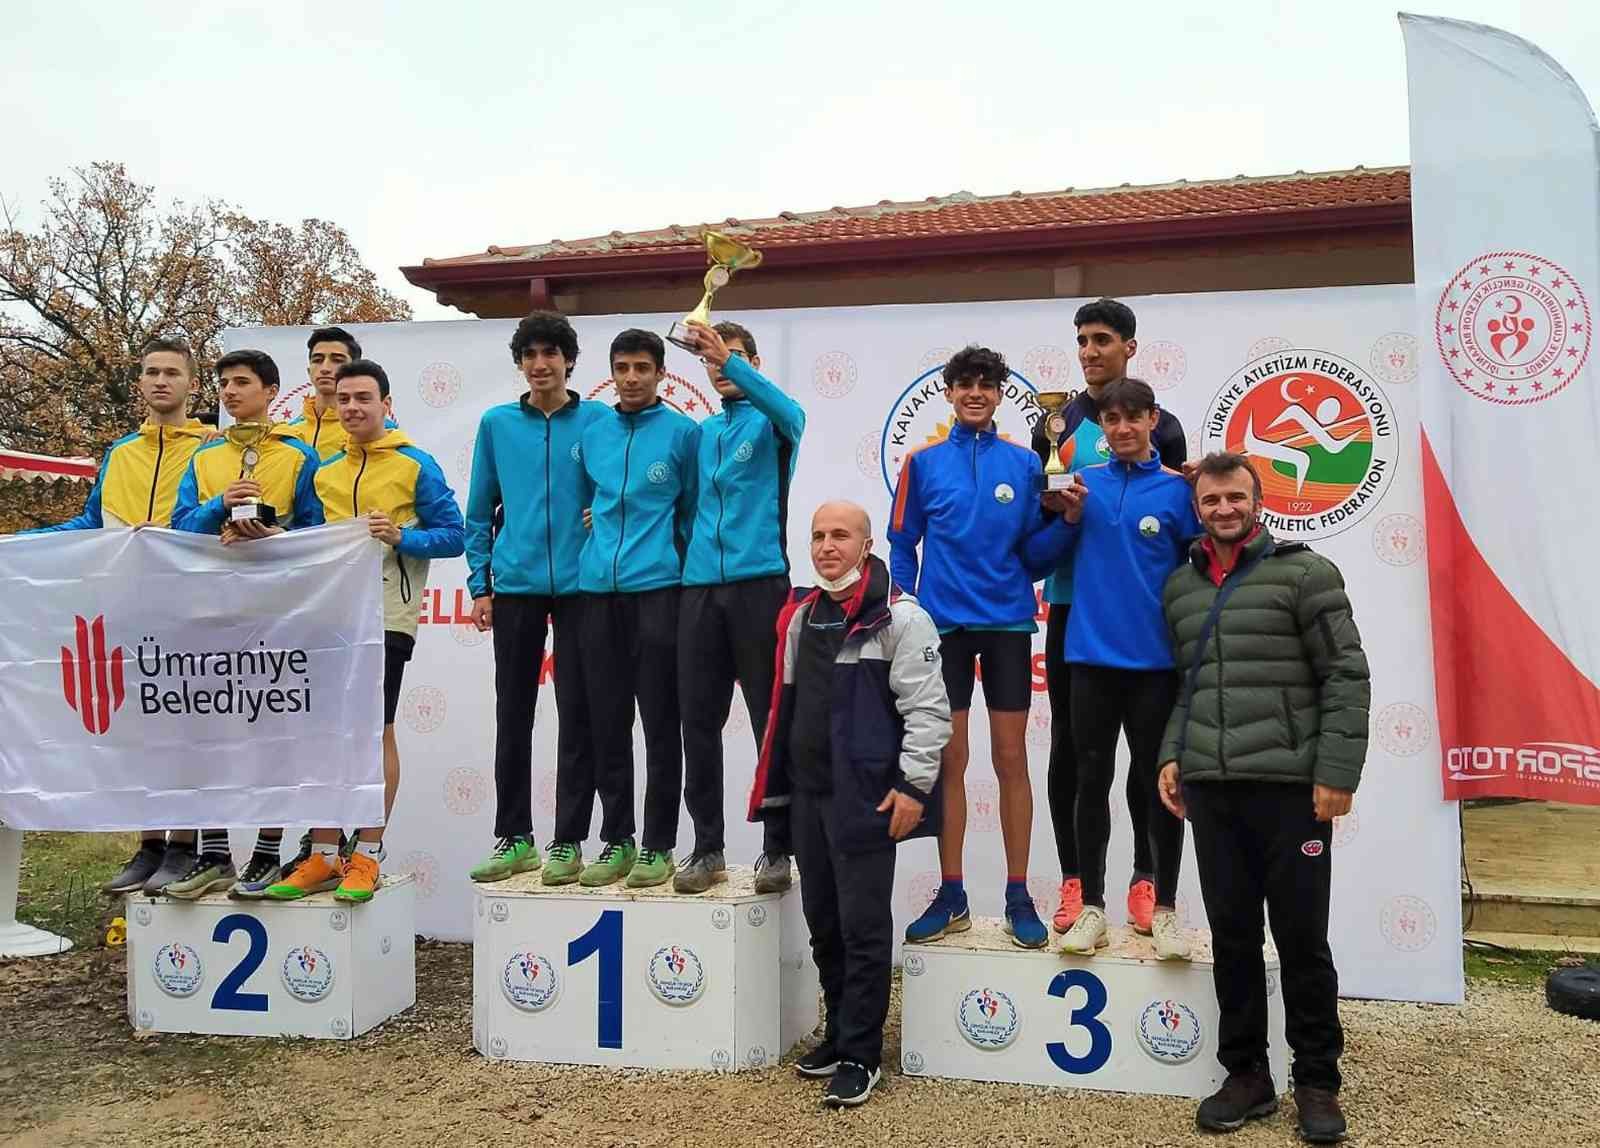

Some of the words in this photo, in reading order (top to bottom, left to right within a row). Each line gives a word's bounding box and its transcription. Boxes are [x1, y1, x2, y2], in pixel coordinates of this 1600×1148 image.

[892, 380, 945, 446] KAVAKL
[1209, 383, 1244, 439] TÜRKİYE
[1244, 355, 1308, 388] ATLETİZM
[1312, 358, 1390, 438] FEDERASYONU
[1262, 512, 1316, 531] THLETIC
[1320, 458, 1387, 529] FEDERATION
[1287, 501, 1312, 512] 1922
[138, 636, 308, 685] Ümraniye
[140, 679, 312, 723] Belediyesi
[210, 912, 269, 1012] 2
[567, 909, 624, 1049] 1
[1045, 968, 1113, 1075] 3
